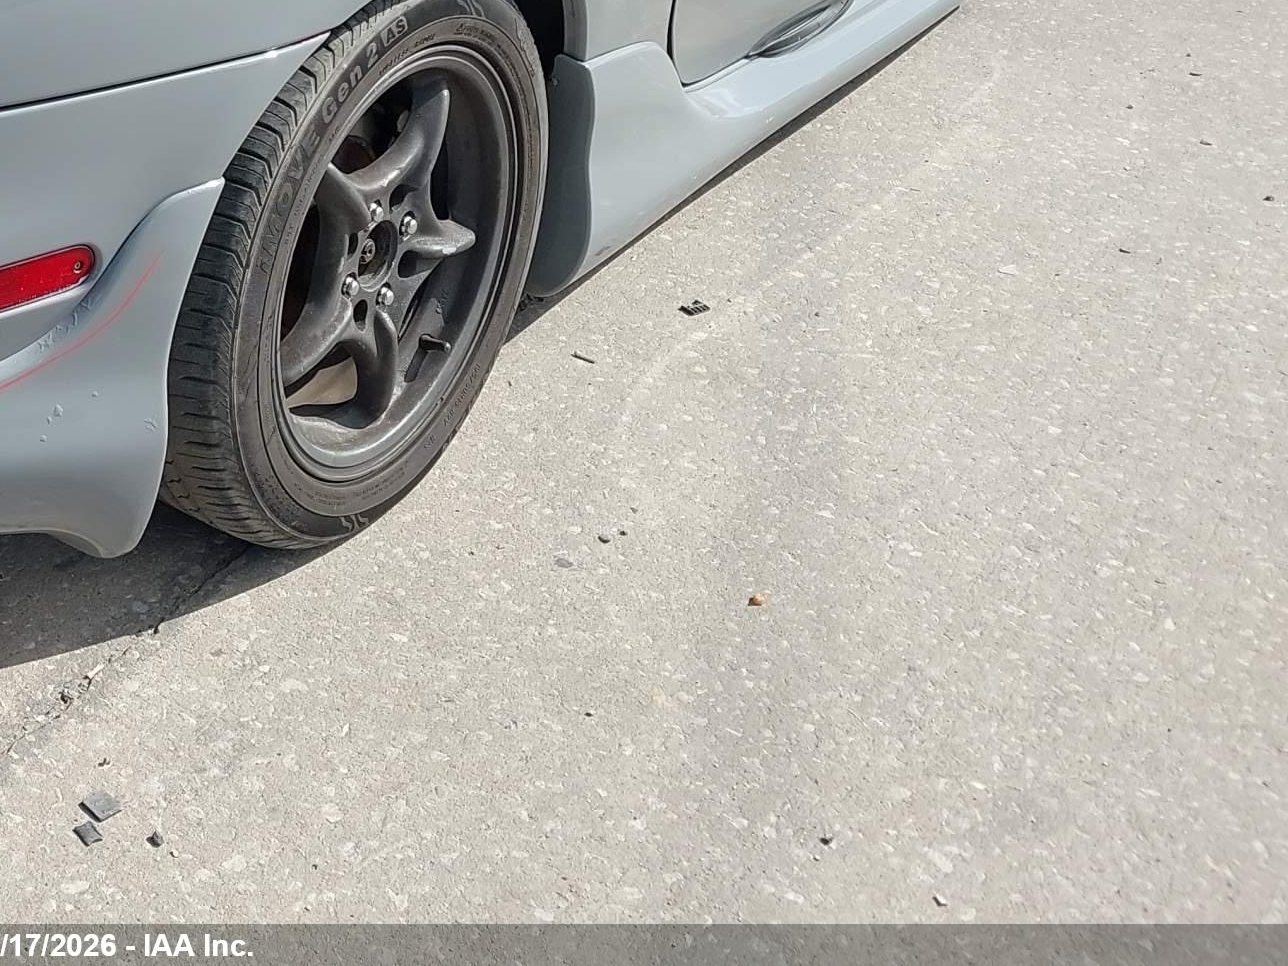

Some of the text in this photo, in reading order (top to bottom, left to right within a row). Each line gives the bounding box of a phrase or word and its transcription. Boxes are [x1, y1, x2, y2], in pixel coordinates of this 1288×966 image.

[321, 65, 363, 124] Gen
[365, 41, 381, 69] 2
[384, 16, 407, 46] AS
